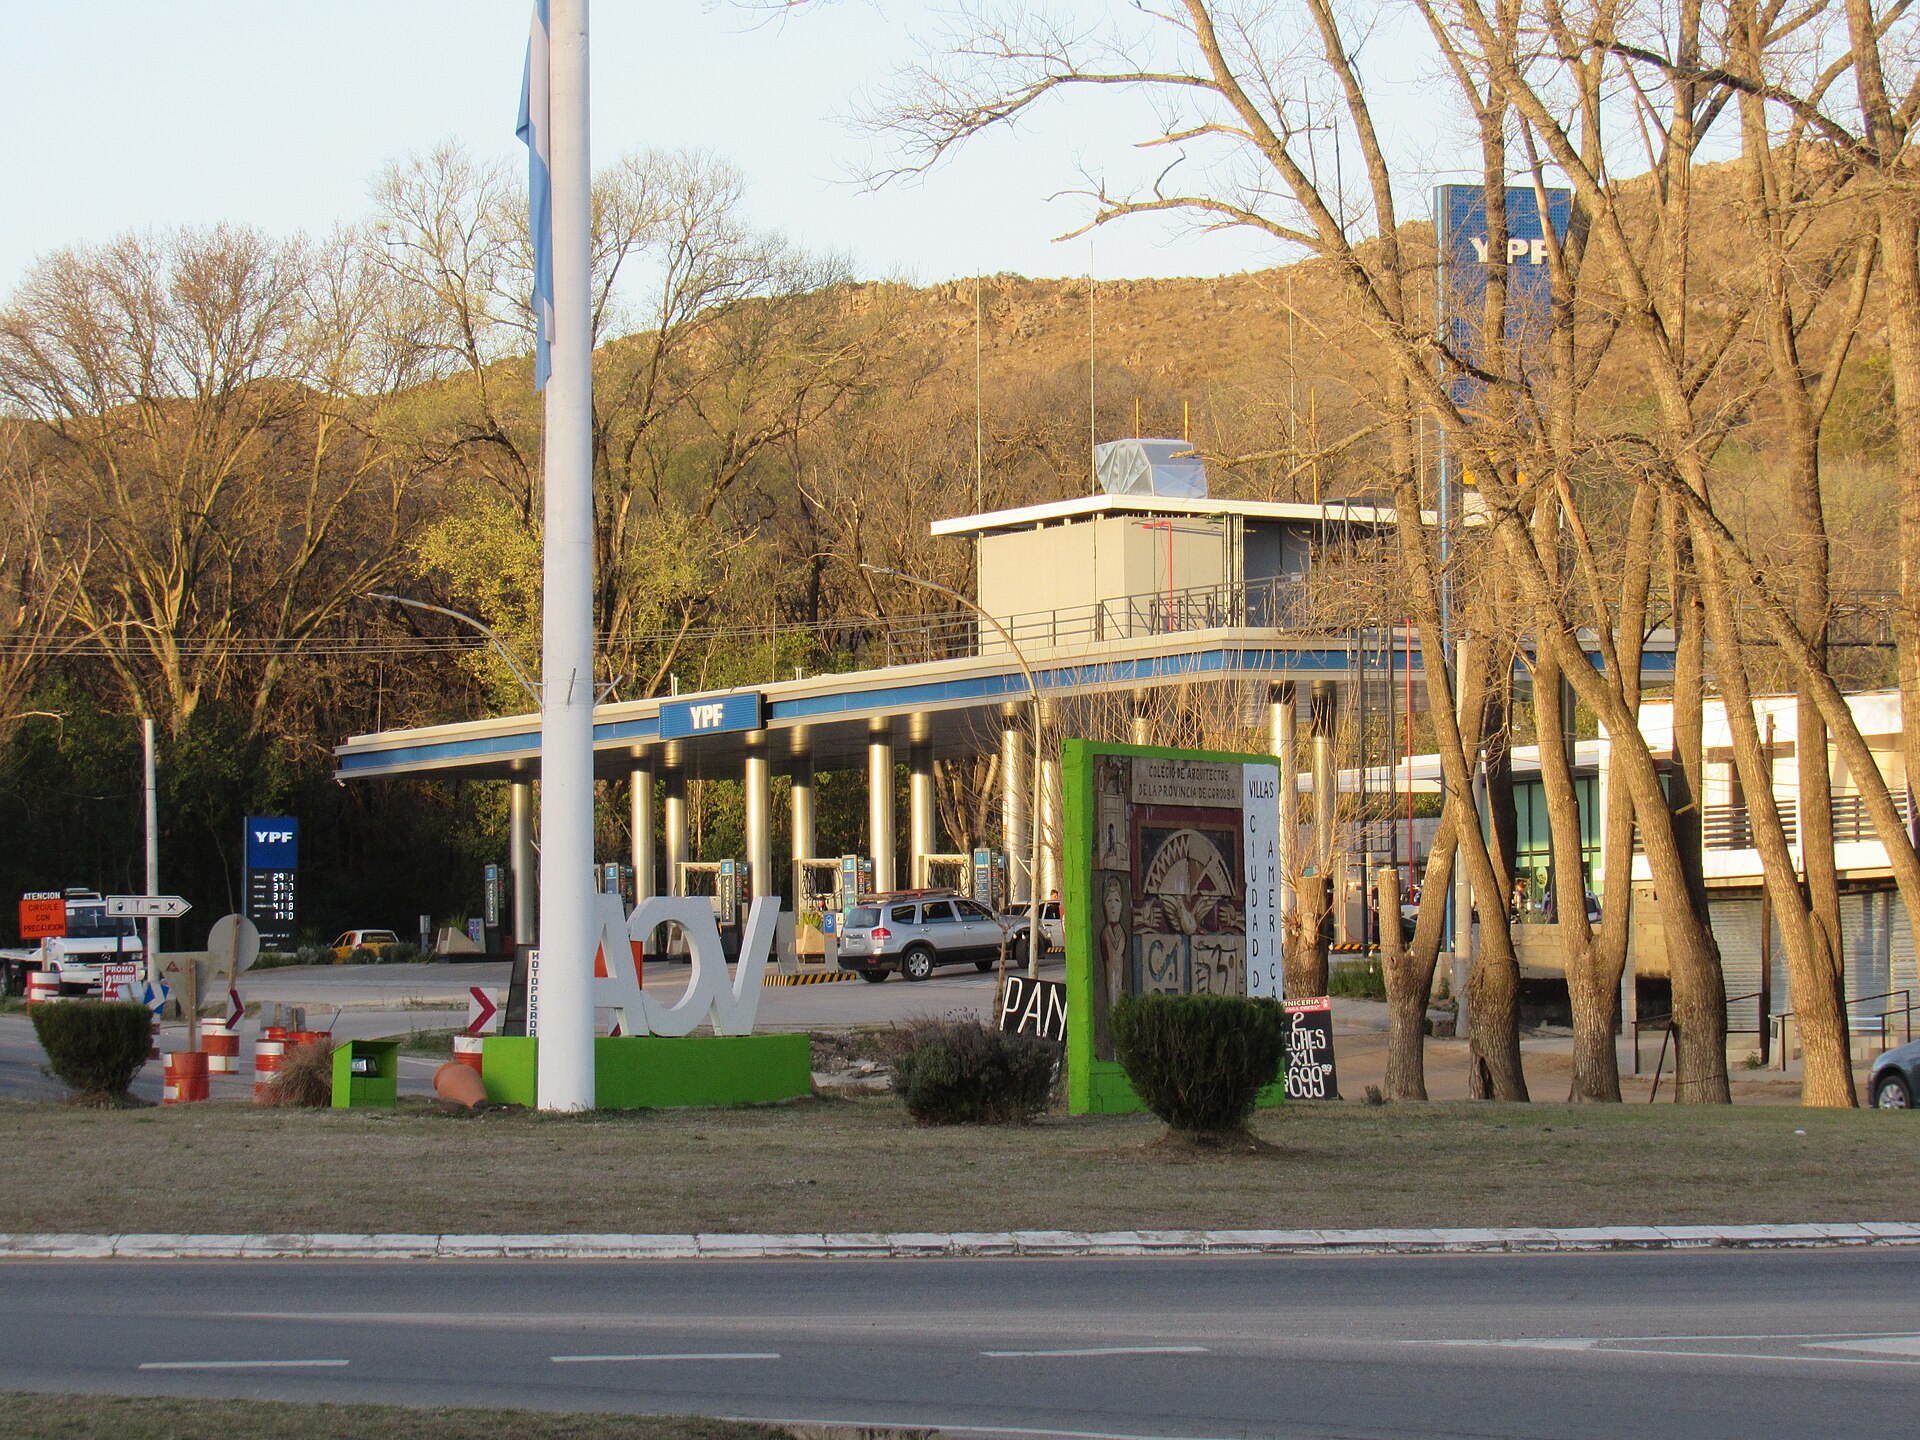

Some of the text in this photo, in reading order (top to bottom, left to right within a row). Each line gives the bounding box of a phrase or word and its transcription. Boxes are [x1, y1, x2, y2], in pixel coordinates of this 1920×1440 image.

[1469, 238, 1548, 264] YPF
[690, 704, 723, 729] YPF
[1177, 767, 1185, 780] DE
[1187, 768, 1229, 781] ARQUITECTOS
[1139, 784, 1235, 800] DE LA PROVINCIA DE CORDOBA
[1249, 780, 1275, 798] VILLAS
[255, 832, 293, 843] YPF
[24, 892, 60, 900] ATENCION
[28, 903, 59, 911] CIRCULE
[24, 924, 64, 932] PRECAUCION
[1267, 840, 1278, 1000] AMERICA
[106, 975, 113, 992] 2
[1000, 977, 1067, 1041] PAN
[1291, 1012, 1307, 1032] 2
